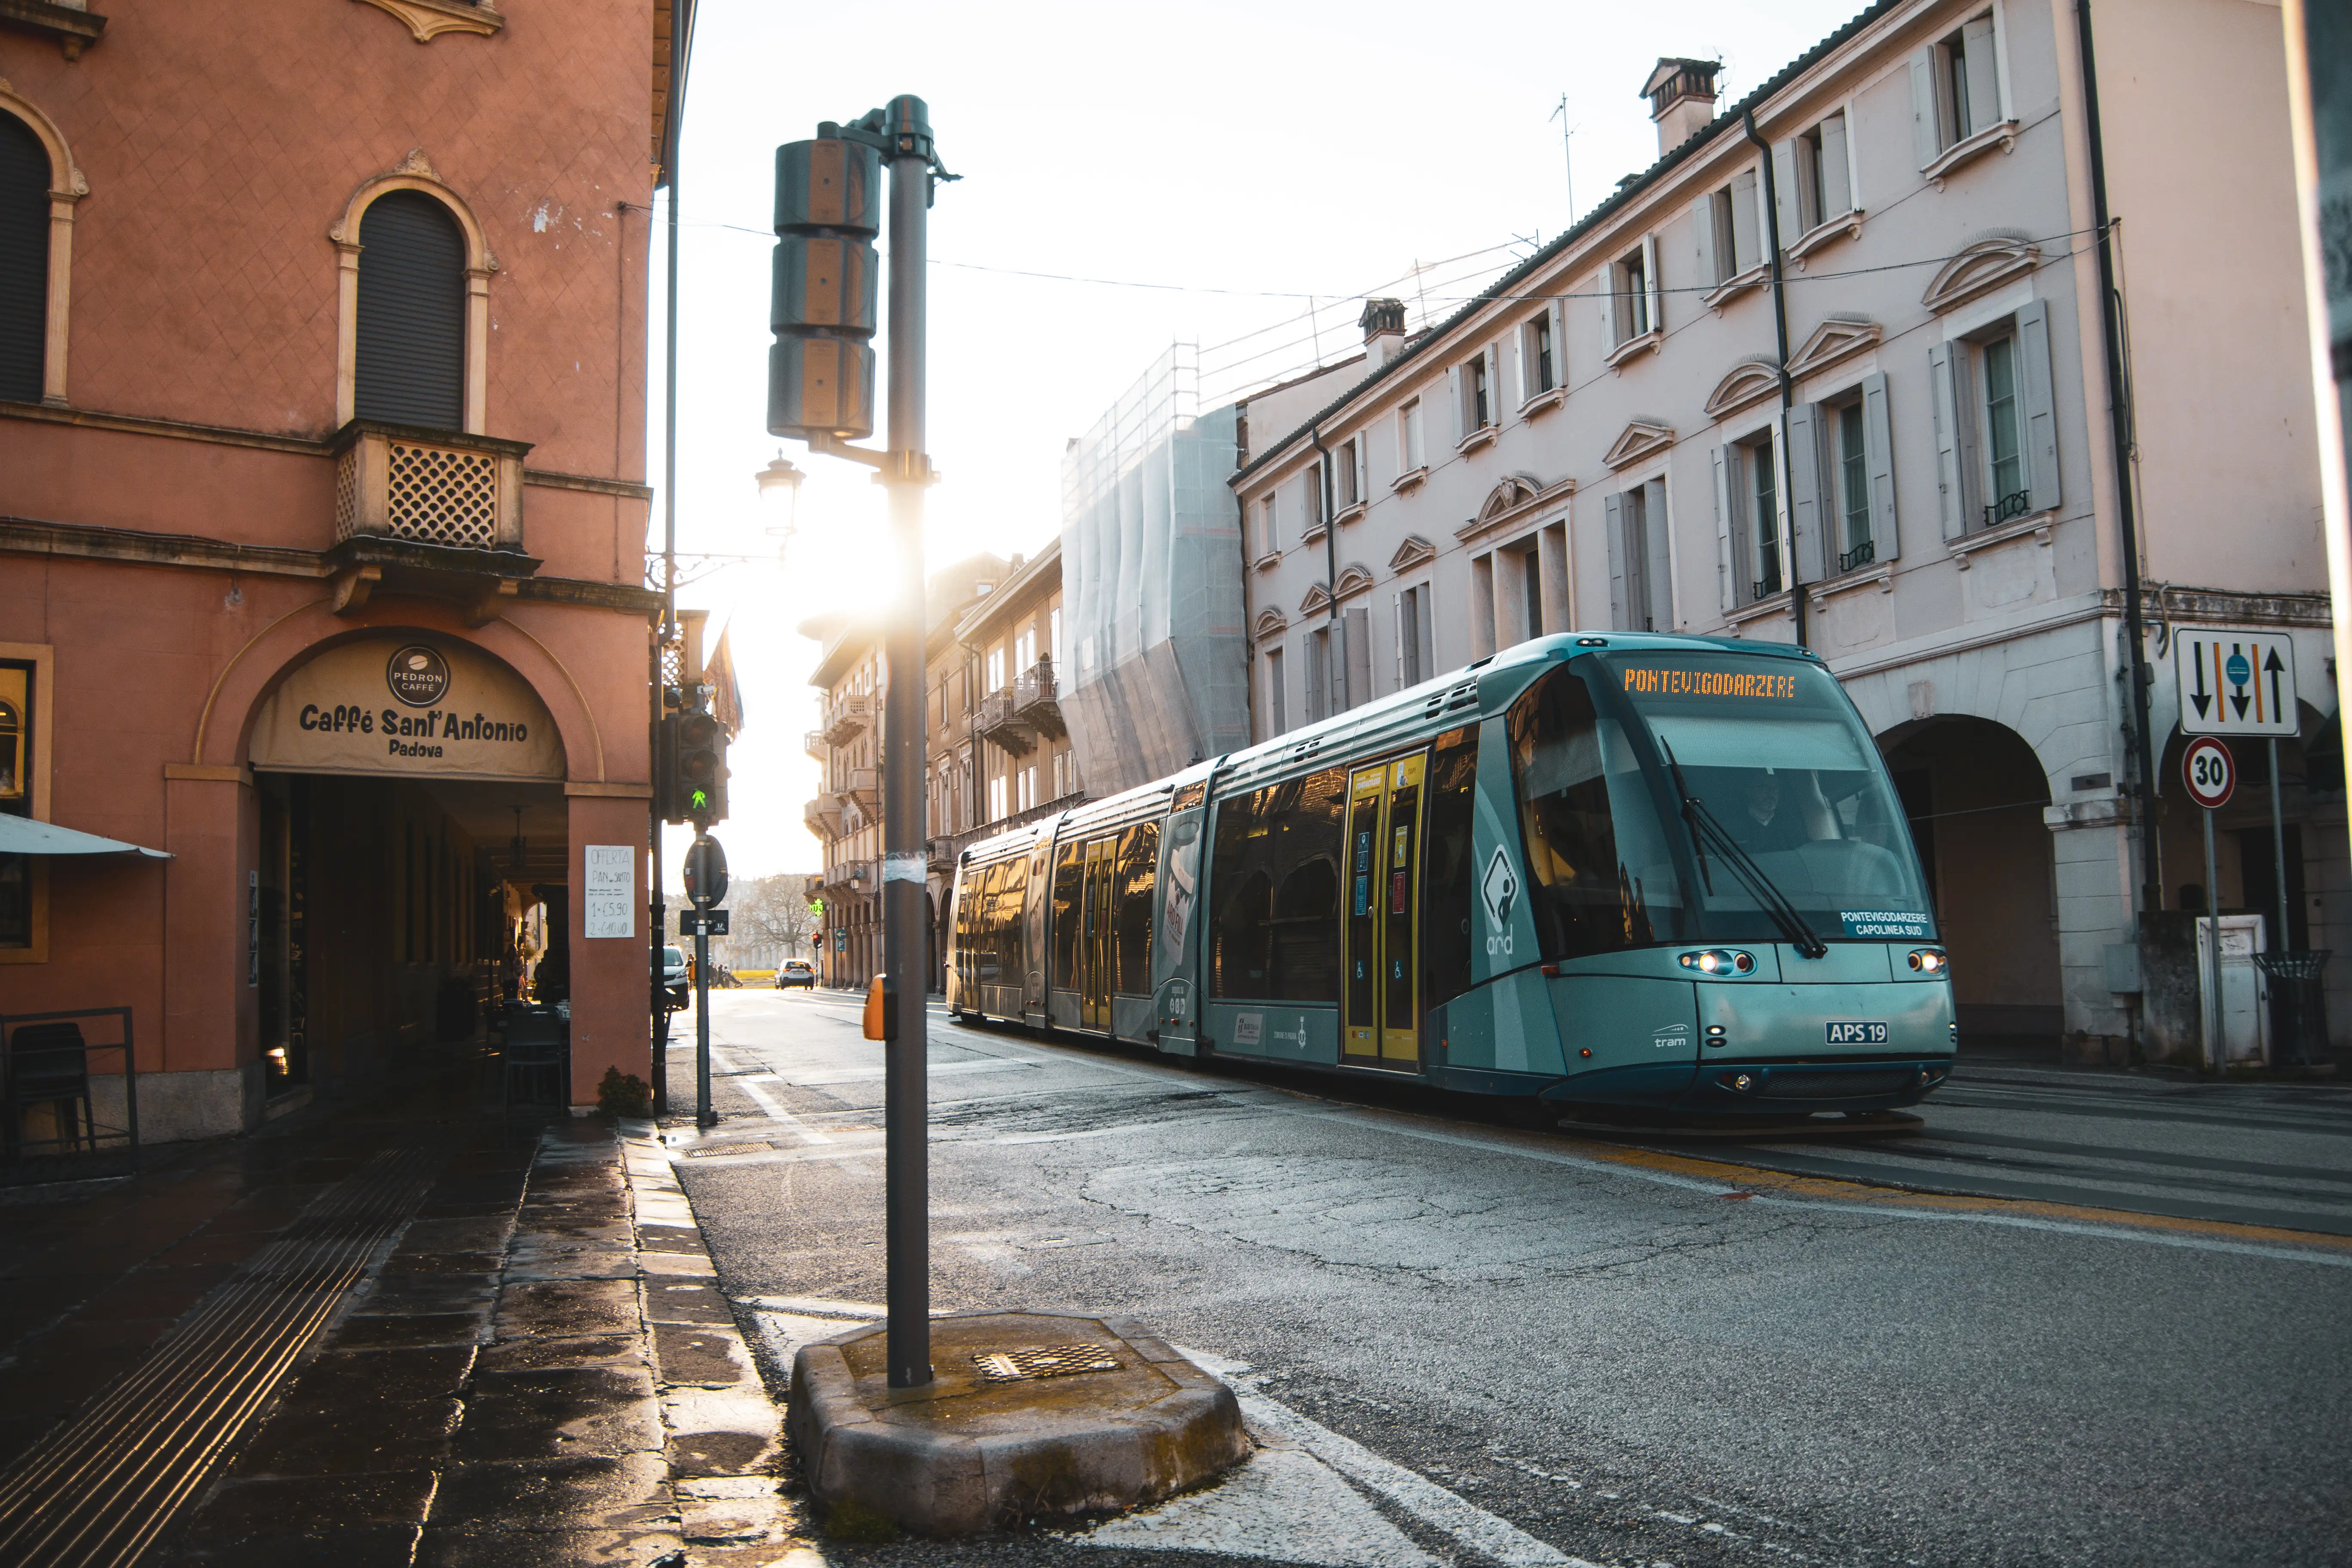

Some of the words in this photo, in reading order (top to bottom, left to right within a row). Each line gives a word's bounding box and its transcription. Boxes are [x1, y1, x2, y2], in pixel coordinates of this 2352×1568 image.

[394, 672, 442, 683] PEDRON
[1625, 669, 1795, 697] PONTEVIGODARZERE
[401, 683, 435, 692] CAFFÈ
[389, 740, 443, 757] Padova
[2196, 756, 2223, 786] 30
[591, 849, 629, 865] OFFERTA
[592, 870, 608, 883] PAN
[1841, 912, 1928, 924] PONTEVIGODARZERE
[1856, 925, 1905, 936] CAPOLINEA
[1905, 925, 1922, 936] SUD
[1487, 924, 1513, 955] ard
[1831, 1024, 1865, 1041] APS
[1868, 1024, 1886, 1042] 19
[1655, 1036, 1686, 1048] tram
